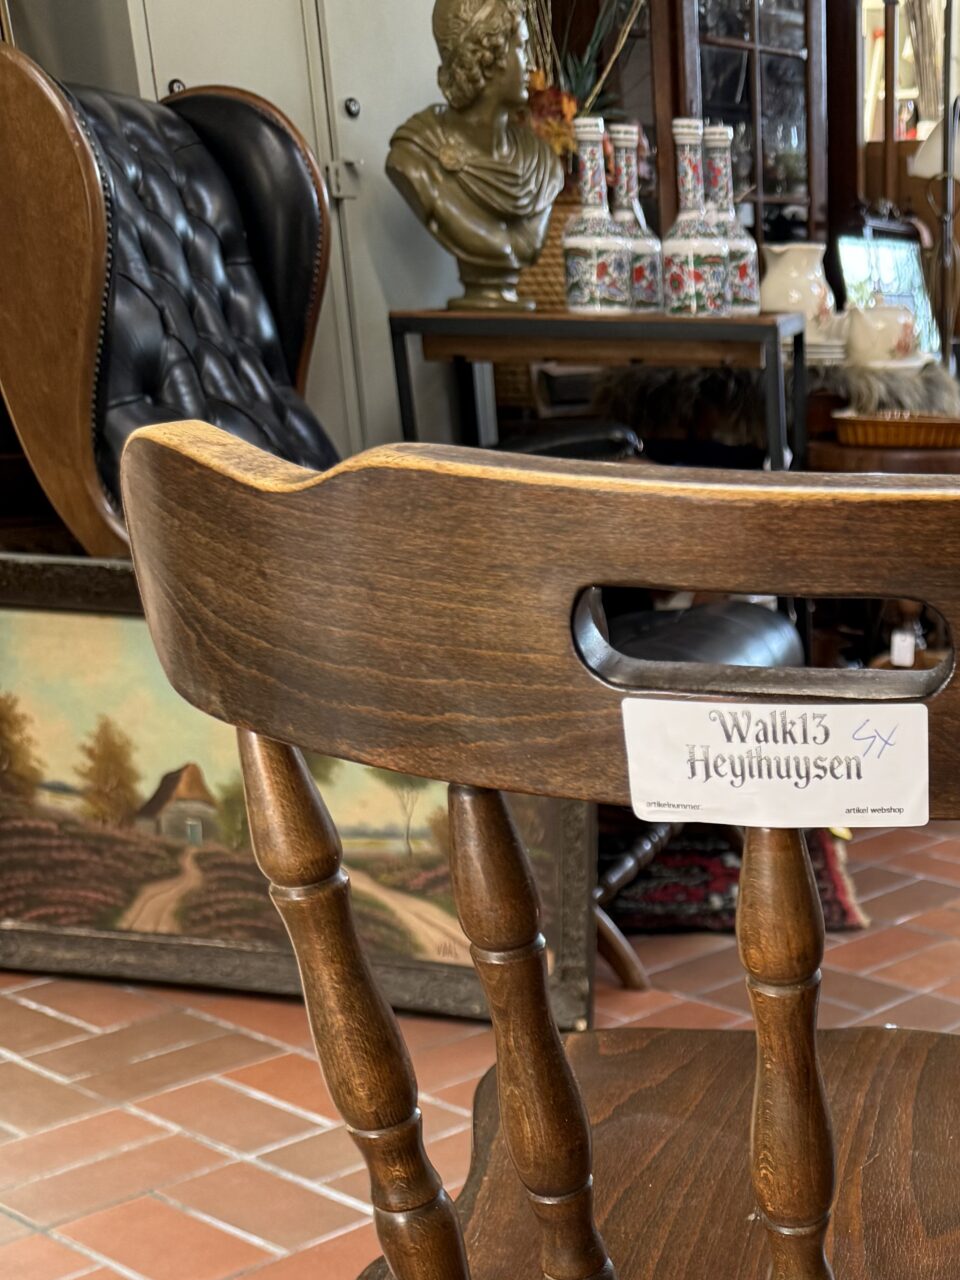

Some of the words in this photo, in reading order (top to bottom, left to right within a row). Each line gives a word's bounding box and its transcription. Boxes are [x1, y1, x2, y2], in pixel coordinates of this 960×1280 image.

[708, 709, 831, 745] Walk13
[685, 743, 863, 789] Heythuysen
[845, 806, 868, 814] artikel
[871, 806, 904, 816] webshop
